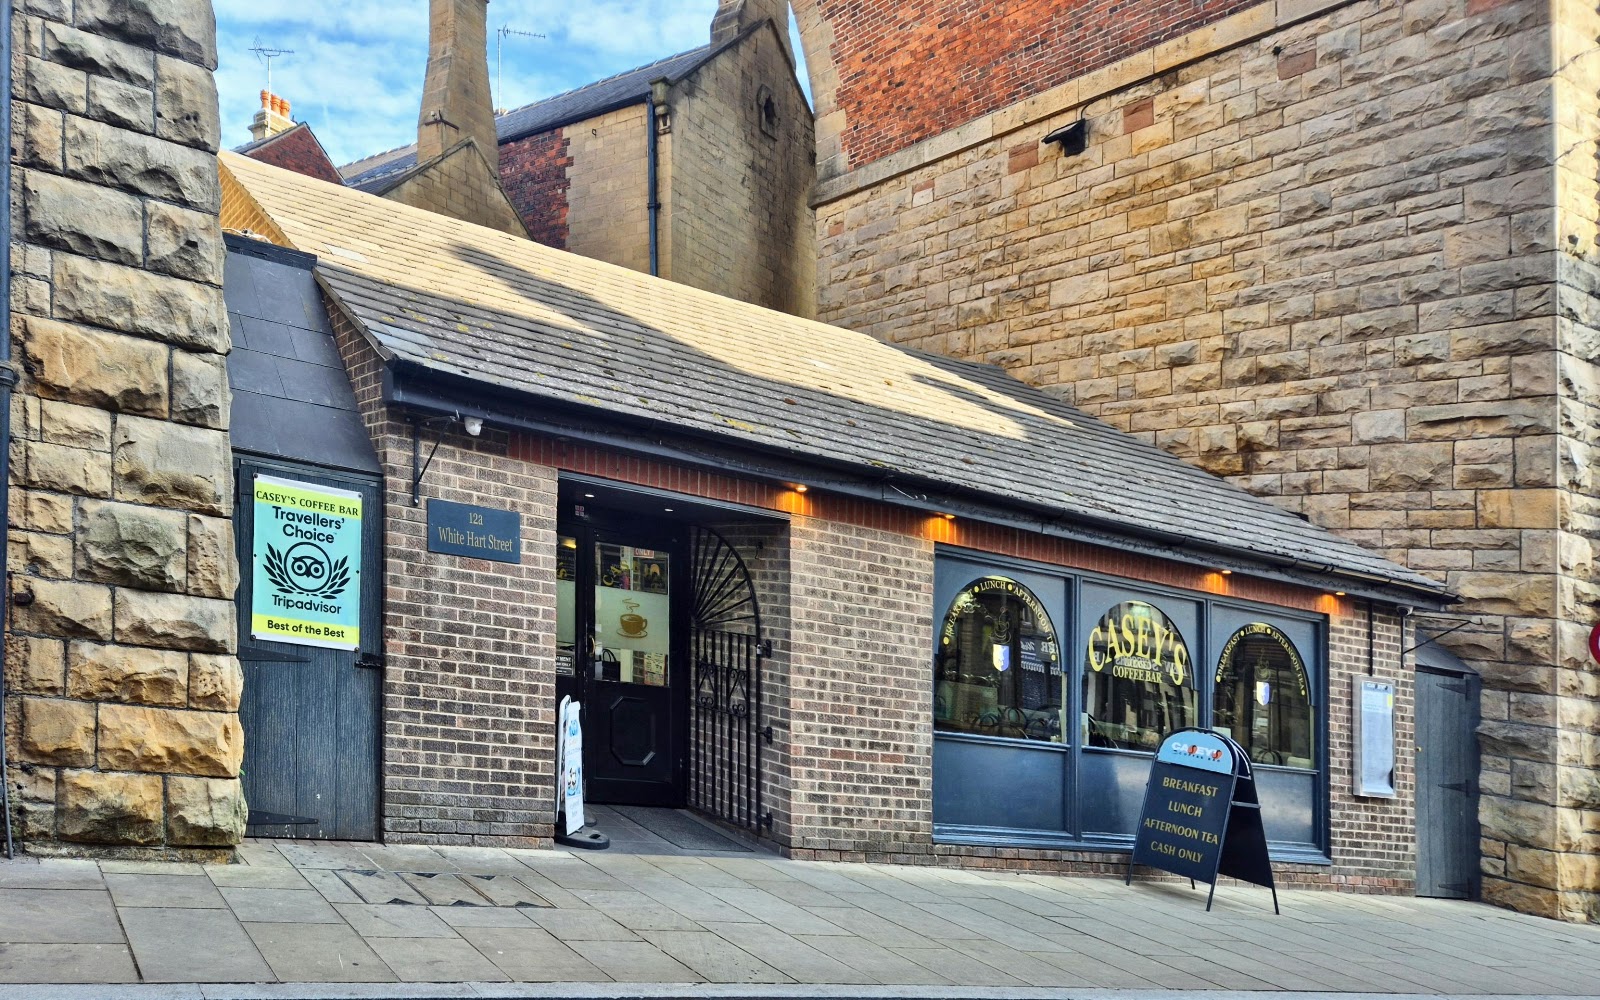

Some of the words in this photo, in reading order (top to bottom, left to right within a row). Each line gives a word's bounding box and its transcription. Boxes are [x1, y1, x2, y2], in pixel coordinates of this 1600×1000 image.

[256, 490, 296, 505] CASEY'S
[299, 498, 336, 513] COFFEE
[339, 505, 359, 516] BAR
[272, 505, 345, 530] Travellers'
[469, 512, 483, 525] 12a
[438, 526, 465, 545] White
[466, 530, 487, 549] Hart
[488, 534, 513, 552] Street
[272, 594, 342, 614] Tripadvisor
[980, 580, 1006, 592] LUNCH
[1013, 587, 1051, 633] AFTERNOON
[267, 620, 290, 632] Best
[291, 623, 303, 633] of
[305, 624, 321, 635] the
[323, 627, 345, 638] Best
[1088, 613, 1187, 686] CASEY'S
[1217, 633, 1240, 676] BREAKFAST
[1245, 625, 1266, 635] LUNCH
[1271, 631, 1301, 671] AFTERNOON
[1112, 665, 1144, 680] COFFEE
[1145, 670, 1163, 683] BAR
[1162, 776, 1219, 797] BREAKFAST
[1168, 800, 1203, 818] LUNCH
[1144, 817, 1199, 840] AFTERNOON
[1201, 831, 1219, 845] TEA
[1150, 840, 1176, 856] CASH
[1178, 847, 1203, 863] ONLY
